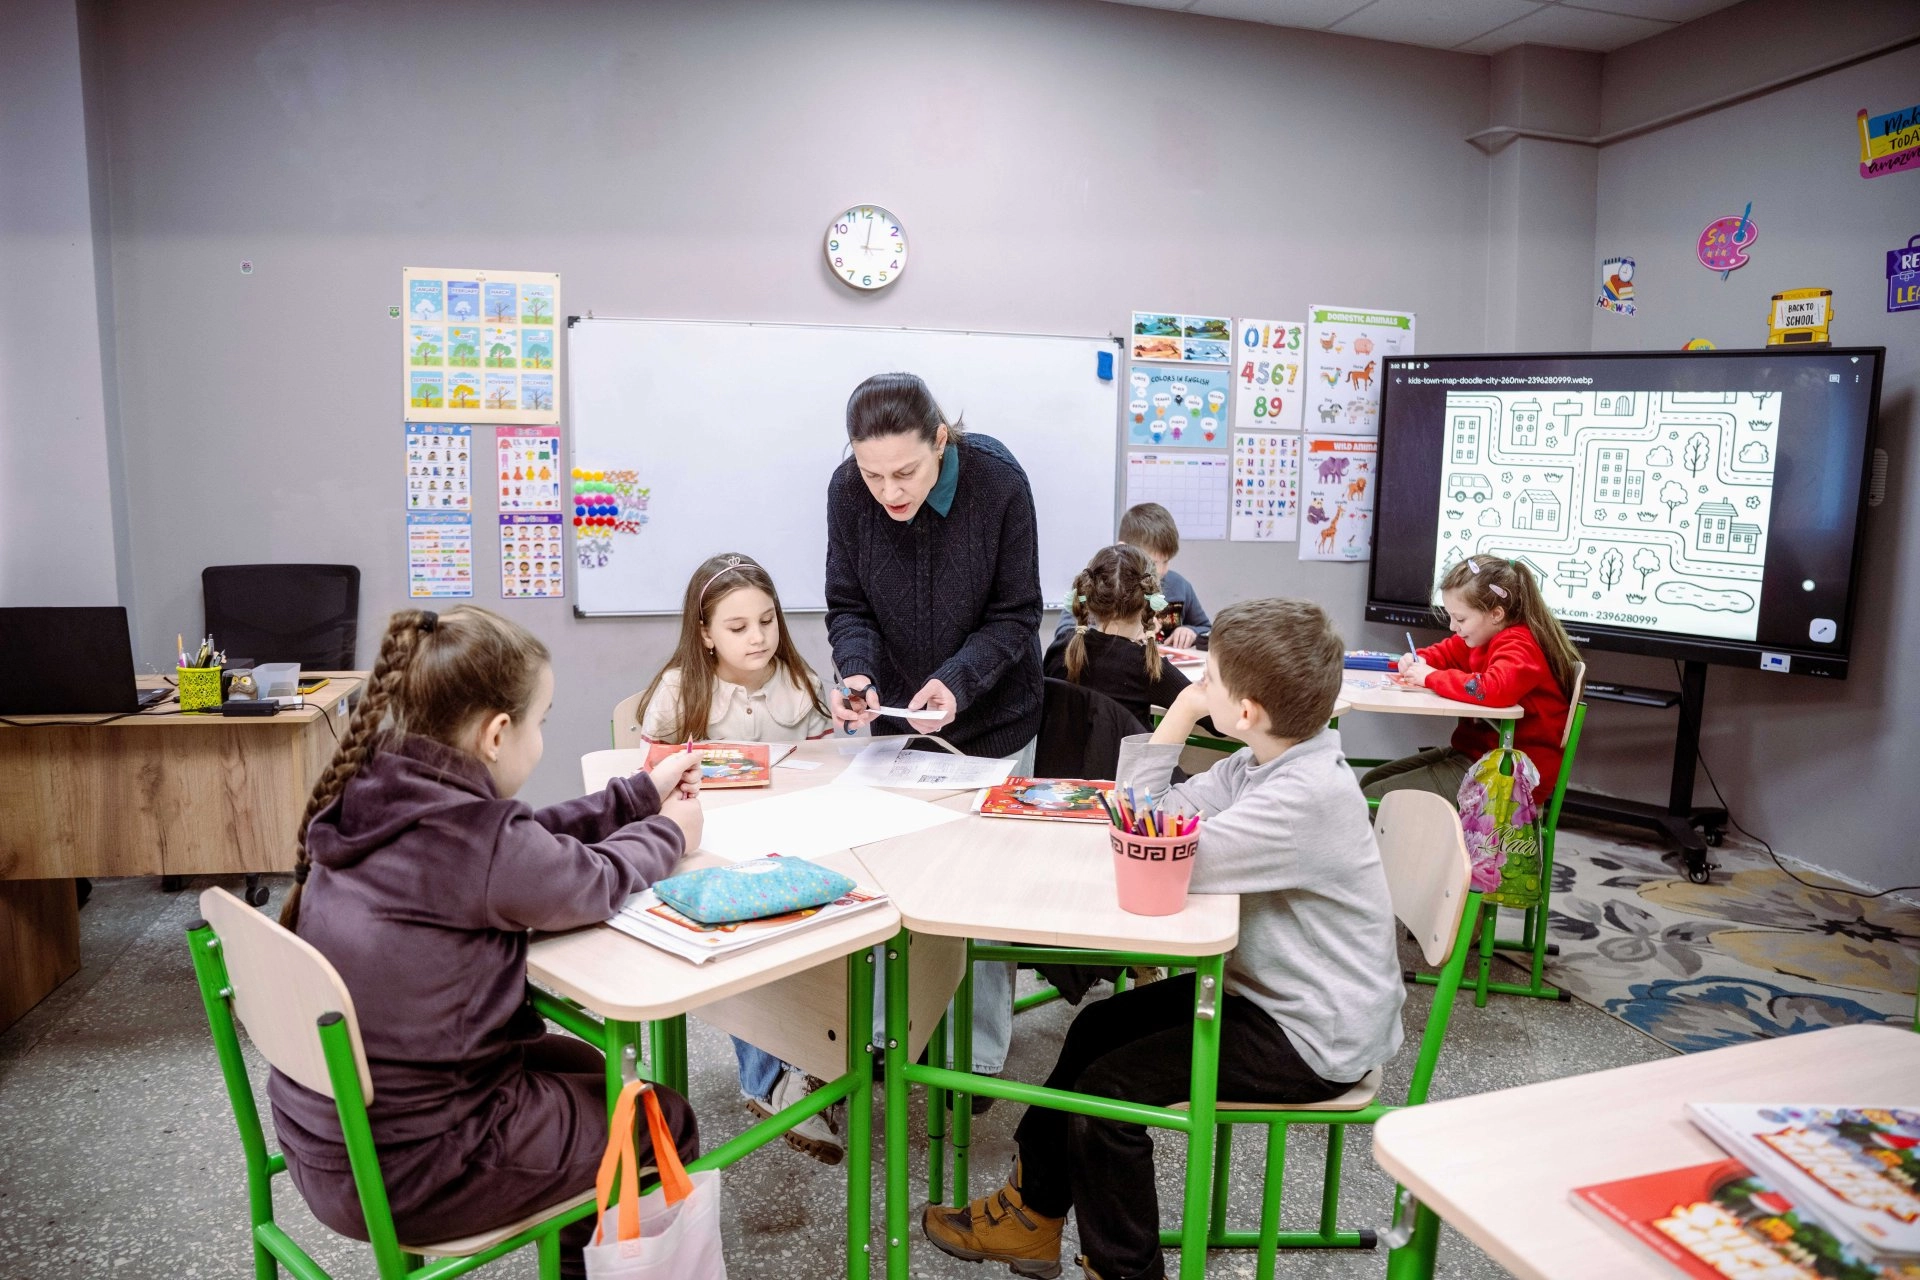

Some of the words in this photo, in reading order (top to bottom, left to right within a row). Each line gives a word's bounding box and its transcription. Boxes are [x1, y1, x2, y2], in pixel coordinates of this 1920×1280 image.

[1889, 128, 1920, 150] TODA
[847, 212, 856, 223] 11
[861, 208, 874, 219] 12
[835, 224, 848, 234] 10
[891, 226, 898, 236] 2
[830, 240, 839, 251] 9
[895, 242, 903, 253] 3
[835, 257, 843, 267] 8
[890, 260, 898, 269] 4
[847, 270, 855, 280] 7
[879, 271, 887, 281] 5
[862, 275, 872, 286] 6
[1596, 296, 1636, 316] HOMEWORK
[1788, 304, 1804, 313] BACK
[1786, 315, 1814, 326] SCHOOL
[1244, 326, 1259, 348] 0
[1262, 326, 1269, 348] 1
[1272, 327, 1286, 349] 2
[1287, 327, 1301, 350] 3
[1241, 362, 1254, 383] 4
[1256, 362, 1269, 384] 5
[1271, 364, 1284, 385] 6
[1287, 364, 1298, 385] 7
[1184, 376, 1210, 386] ENGLISH
[1254, 396, 1267, 417] 8
[1268, 397, 1282, 417] 9
[1248, 438, 1254, 446] B
[1260, 438, 1265, 446] C
[1334, 443, 1353, 451] WILD
[1291, 460, 1296, 468] L
[1247, 479, 1253, 487] N
[1280, 480, 1286, 488] Q
[1257, 500, 1263, 508] U
[1596, 610, 1657, 625] 2396280999
